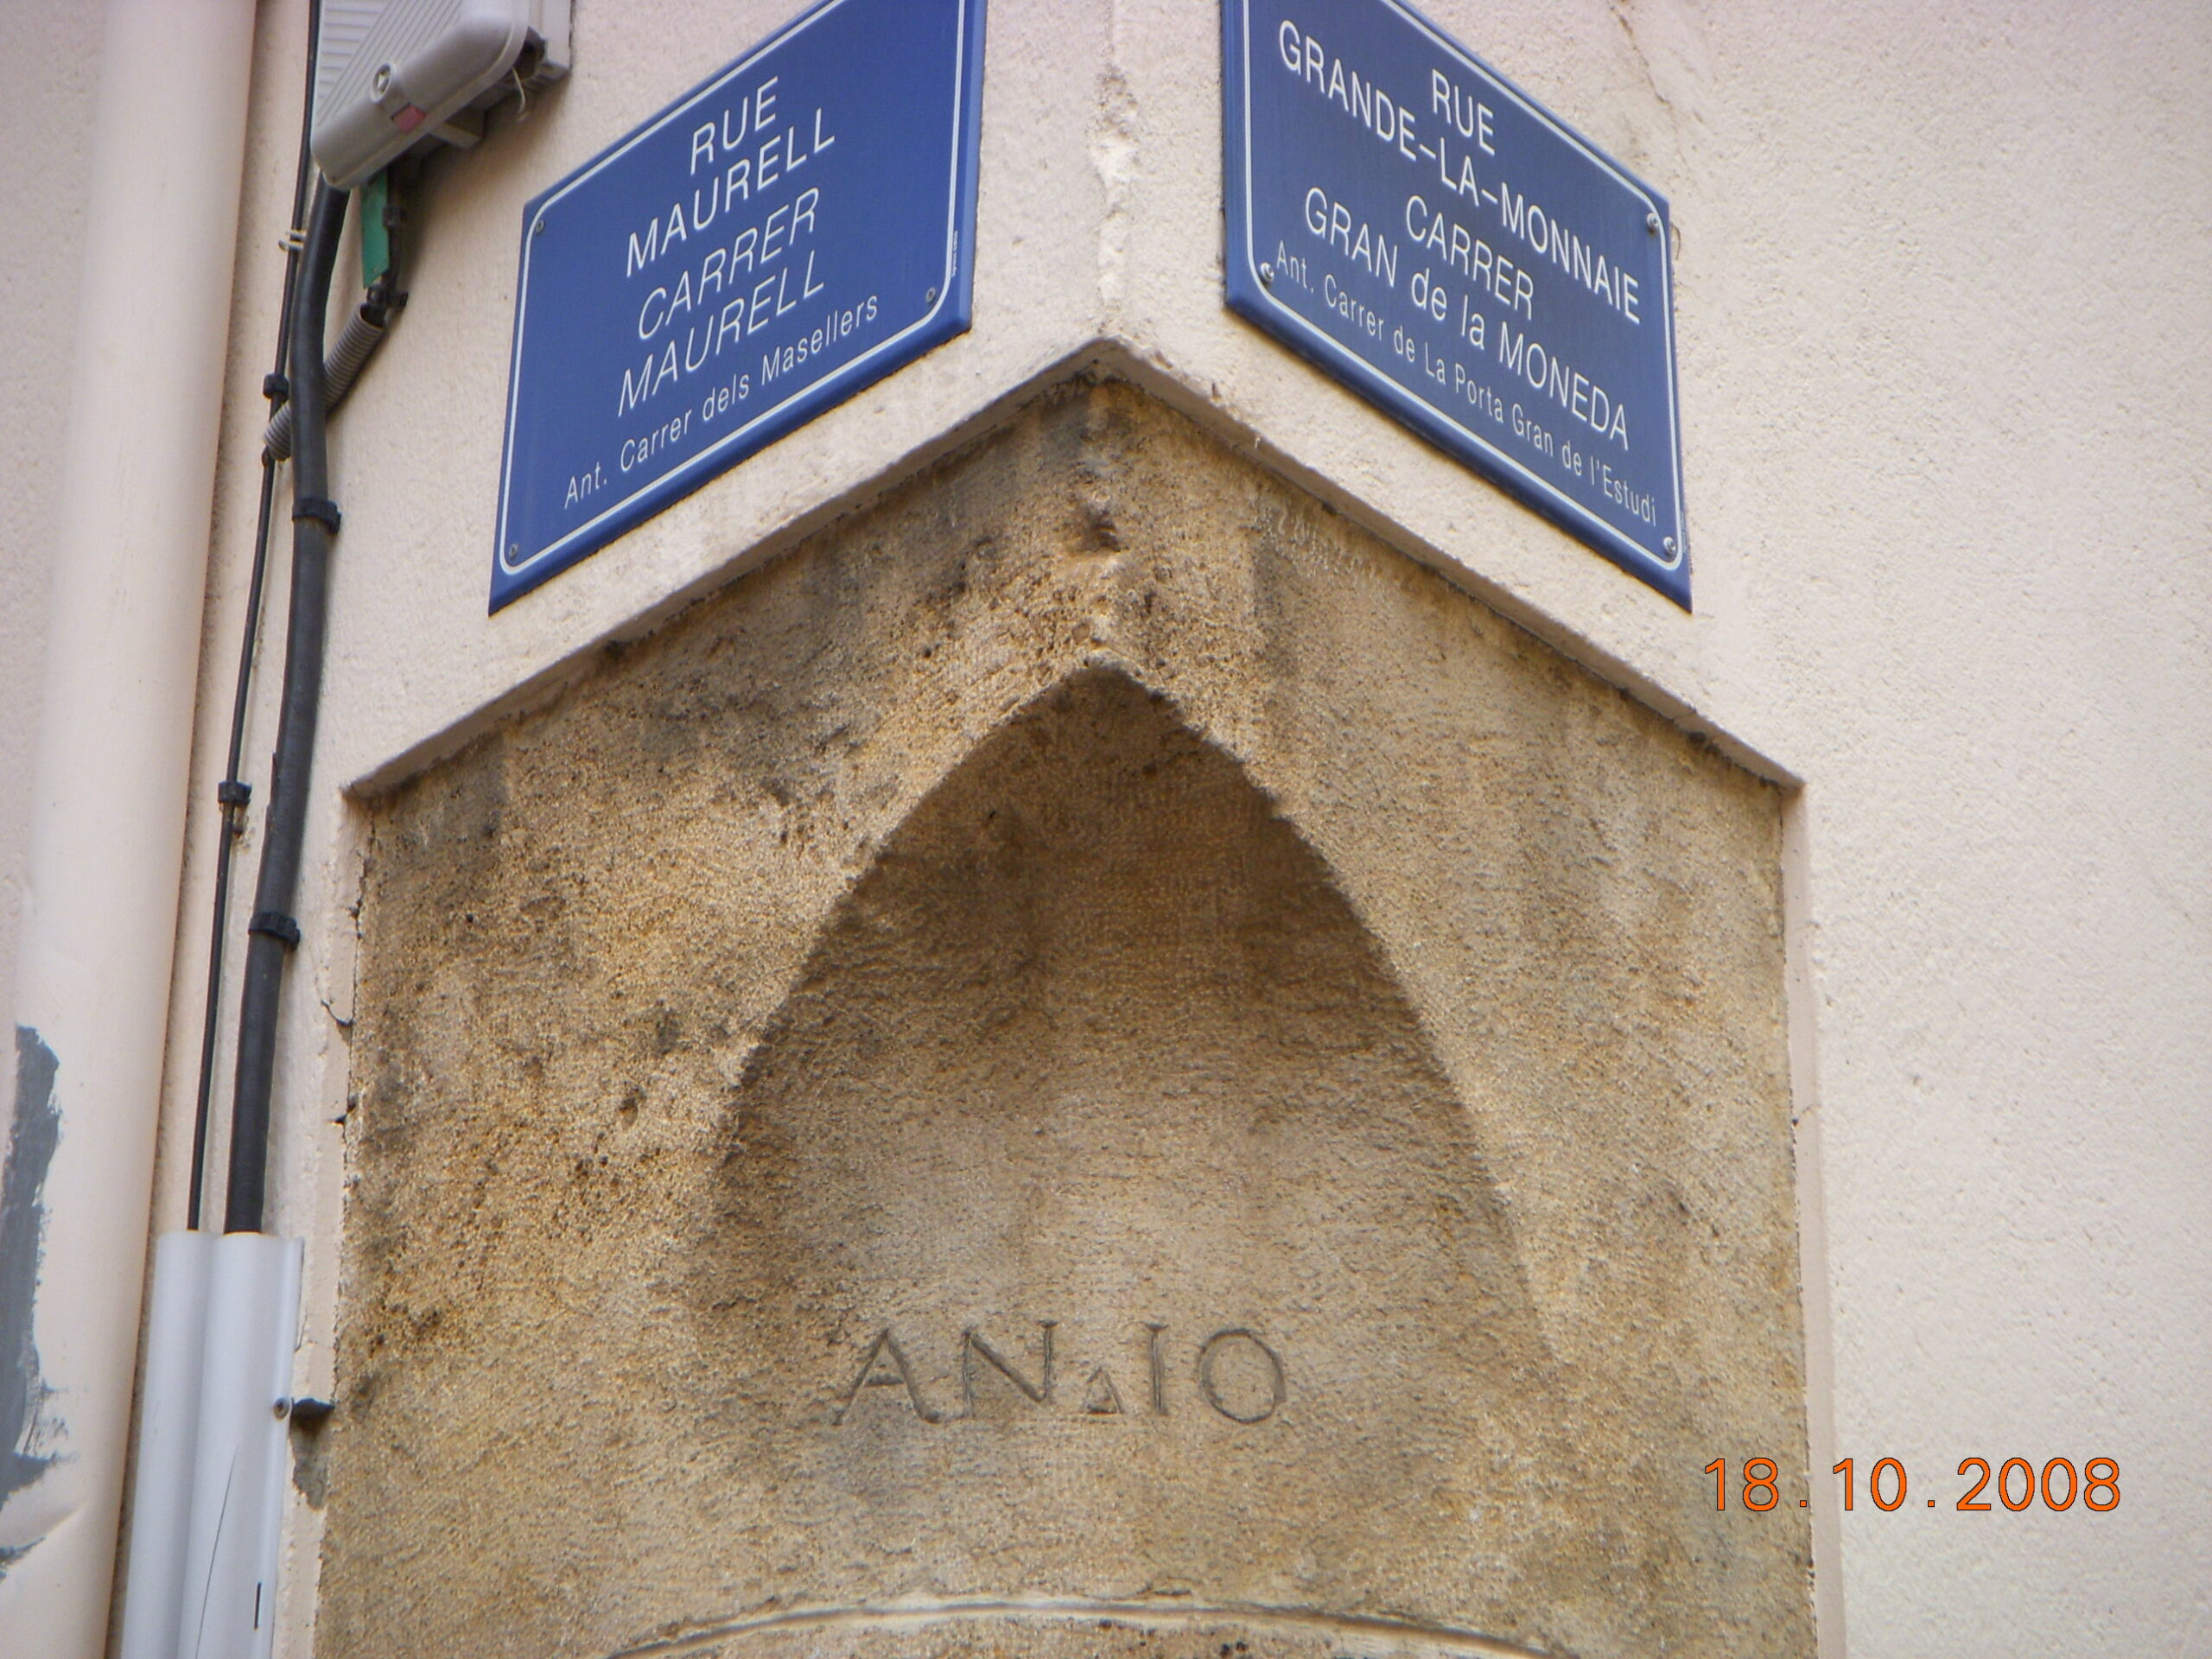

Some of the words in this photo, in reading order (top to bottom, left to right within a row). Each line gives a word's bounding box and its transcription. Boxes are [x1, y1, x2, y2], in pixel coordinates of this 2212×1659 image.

[627, 109, 836, 277] MAURELL
[691, 76, 778, 175] RUE
[1279, 20, 1640, 324] GRANDE-LA-MONNAIE
[1432, 69, 1495, 156] RUE
[619, 251, 824, 417] MAURELL
[639, 188, 819, 340] CARRER
[1305, 188, 1397, 288] GRAN
[1411, 268, 1447, 322] de
[1461, 295, 1485, 351] la
[1499, 321, 1629, 451] MONEDA
[1406, 195, 1534, 321] CARRER
[564, 462, 607, 509] Ant.
[620, 410, 692, 473] Carrer
[702, 375, 749, 422] dels
[762, 295, 878, 385] Masellers
[1276, 240, 1314, 294] Ant.
[1325, 274, 1384, 341] Carrer
[1394, 325, 1415, 364] de
[1425, 342, 1446, 385] La
[1455, 363, 1504, 424] Porta
[1512, 404, 1554, 457] Gran
[1562, 439, 1582, 477] de
[1590, 455, 1656, 527] l'Estudi
